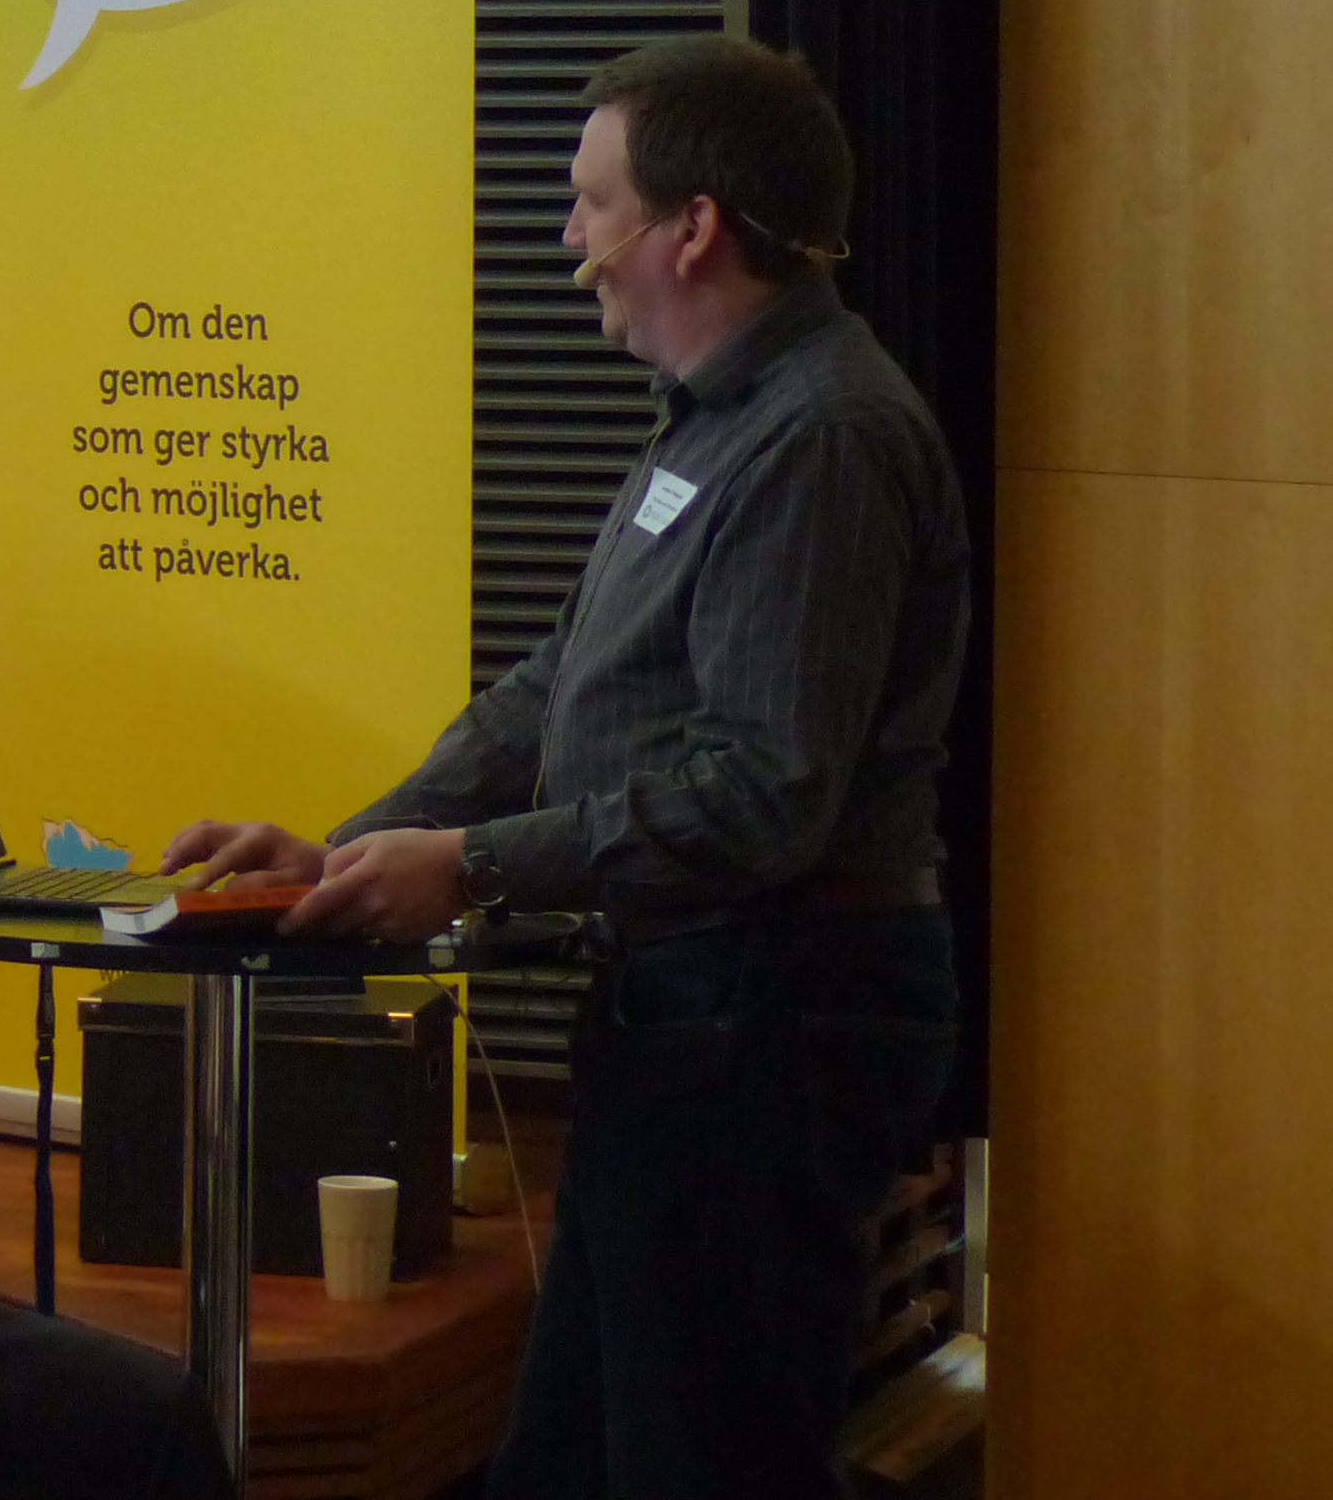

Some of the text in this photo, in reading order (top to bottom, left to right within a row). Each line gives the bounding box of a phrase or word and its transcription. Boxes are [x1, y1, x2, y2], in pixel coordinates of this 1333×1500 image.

[129, 302, 267, 340] Om den
[100, 364, 299, 410] gemenskap
[74, 425, 329, 469] som ger styrka
[79, 477, 322, 529] och möjlighet
[99, 539, 299, 582] att påverka.
